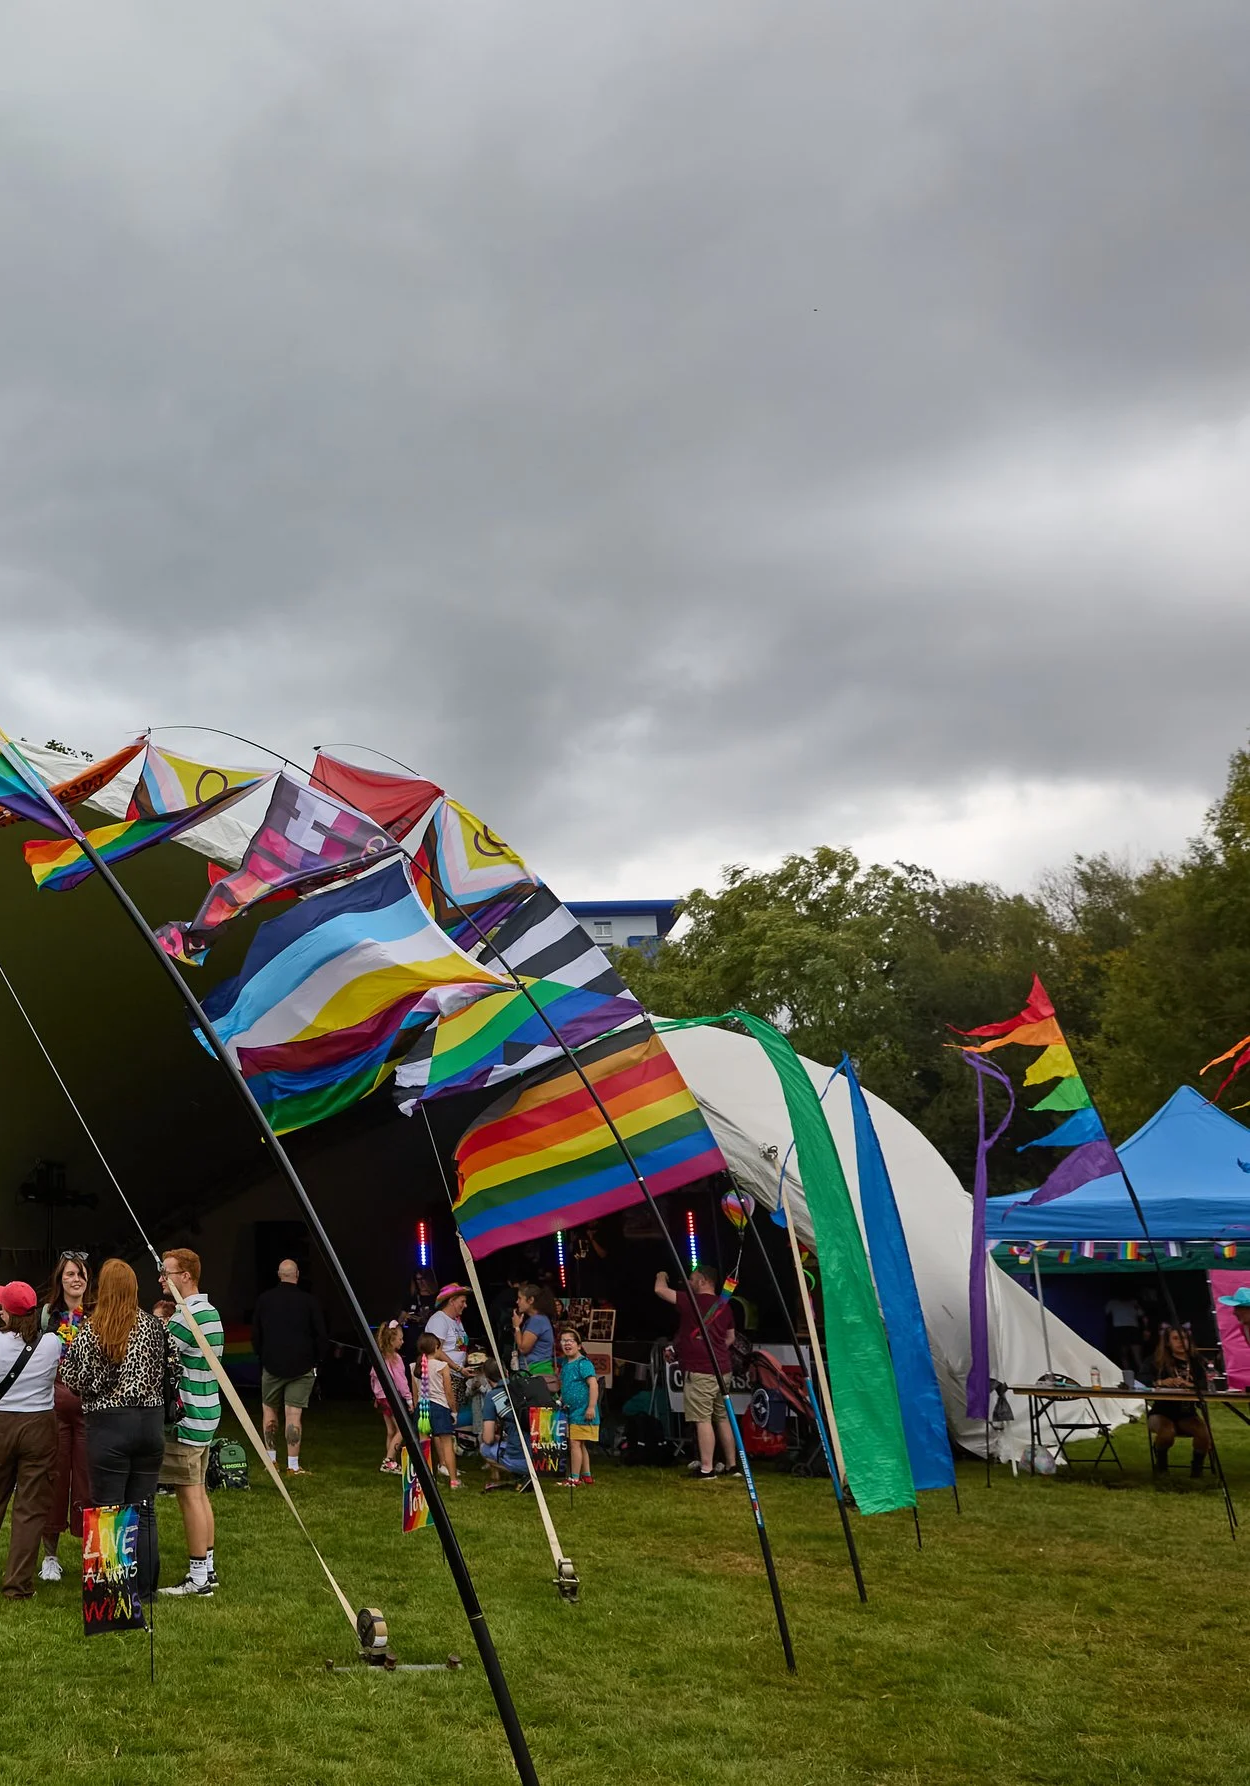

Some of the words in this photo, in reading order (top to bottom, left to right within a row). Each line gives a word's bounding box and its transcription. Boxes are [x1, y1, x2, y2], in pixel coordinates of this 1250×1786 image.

[530, 1419, 567, 1437] LOVE
[409, 1487, 427, 1517] lov
[83, 1525, 139, 1560] LOVE
[83, 1560, 138, 1583] ALWAYS
[83, 1593, 142, 1623] WINS
